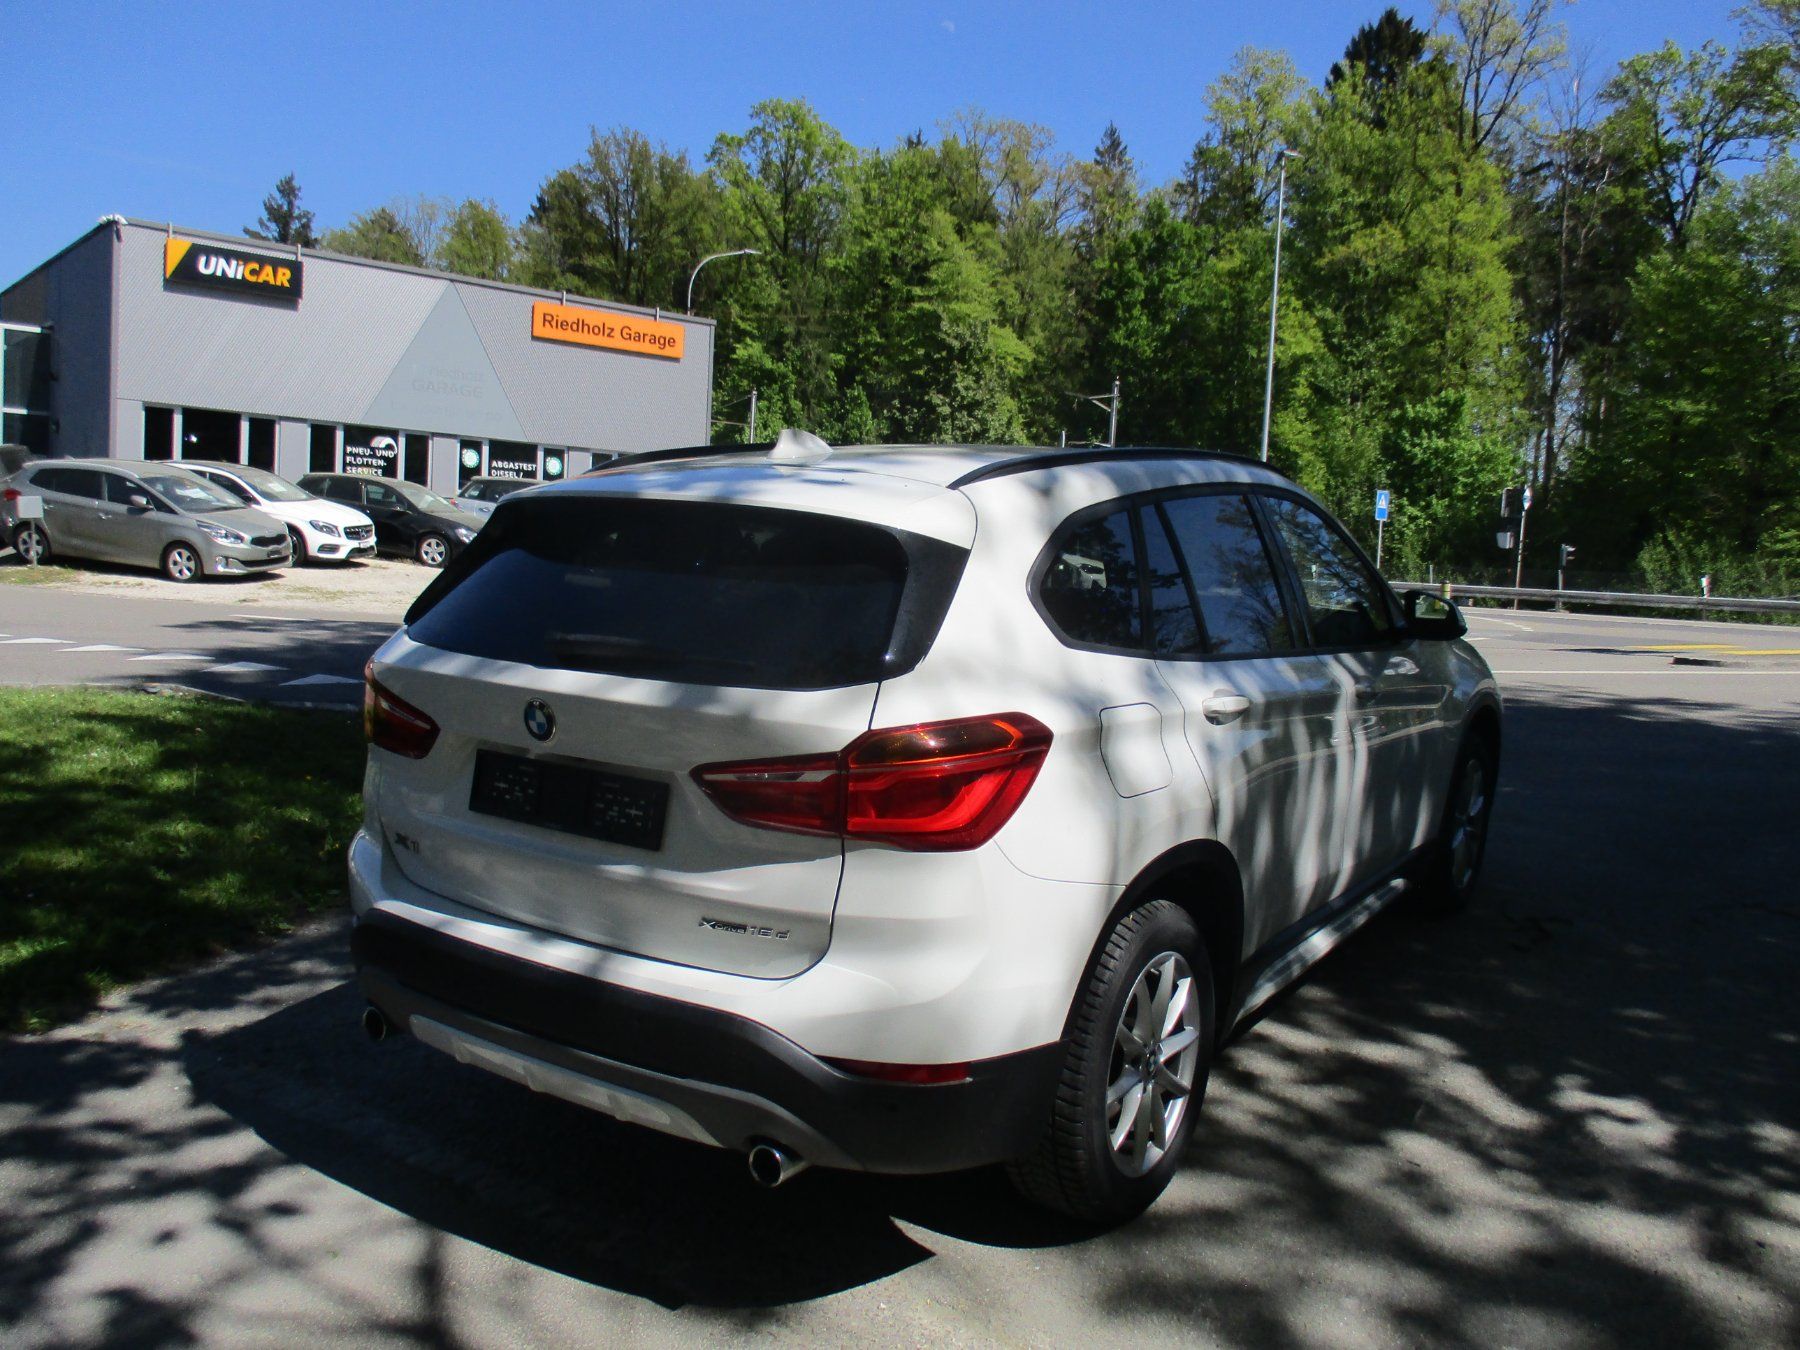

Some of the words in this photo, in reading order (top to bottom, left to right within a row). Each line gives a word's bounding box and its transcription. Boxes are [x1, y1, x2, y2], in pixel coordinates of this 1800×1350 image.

[542, 312, 615, 340] Riedholz
[620, 325, 677, 350] Garage
[346, 445, 373, 456] PNEU-
[375, 448, 395, 458] UND
[346, 456, 387, 467] FLOTTEN-
[491, 460, 537, 472] ABGASTEST
[346, 466, 383, 477] SERVICE
